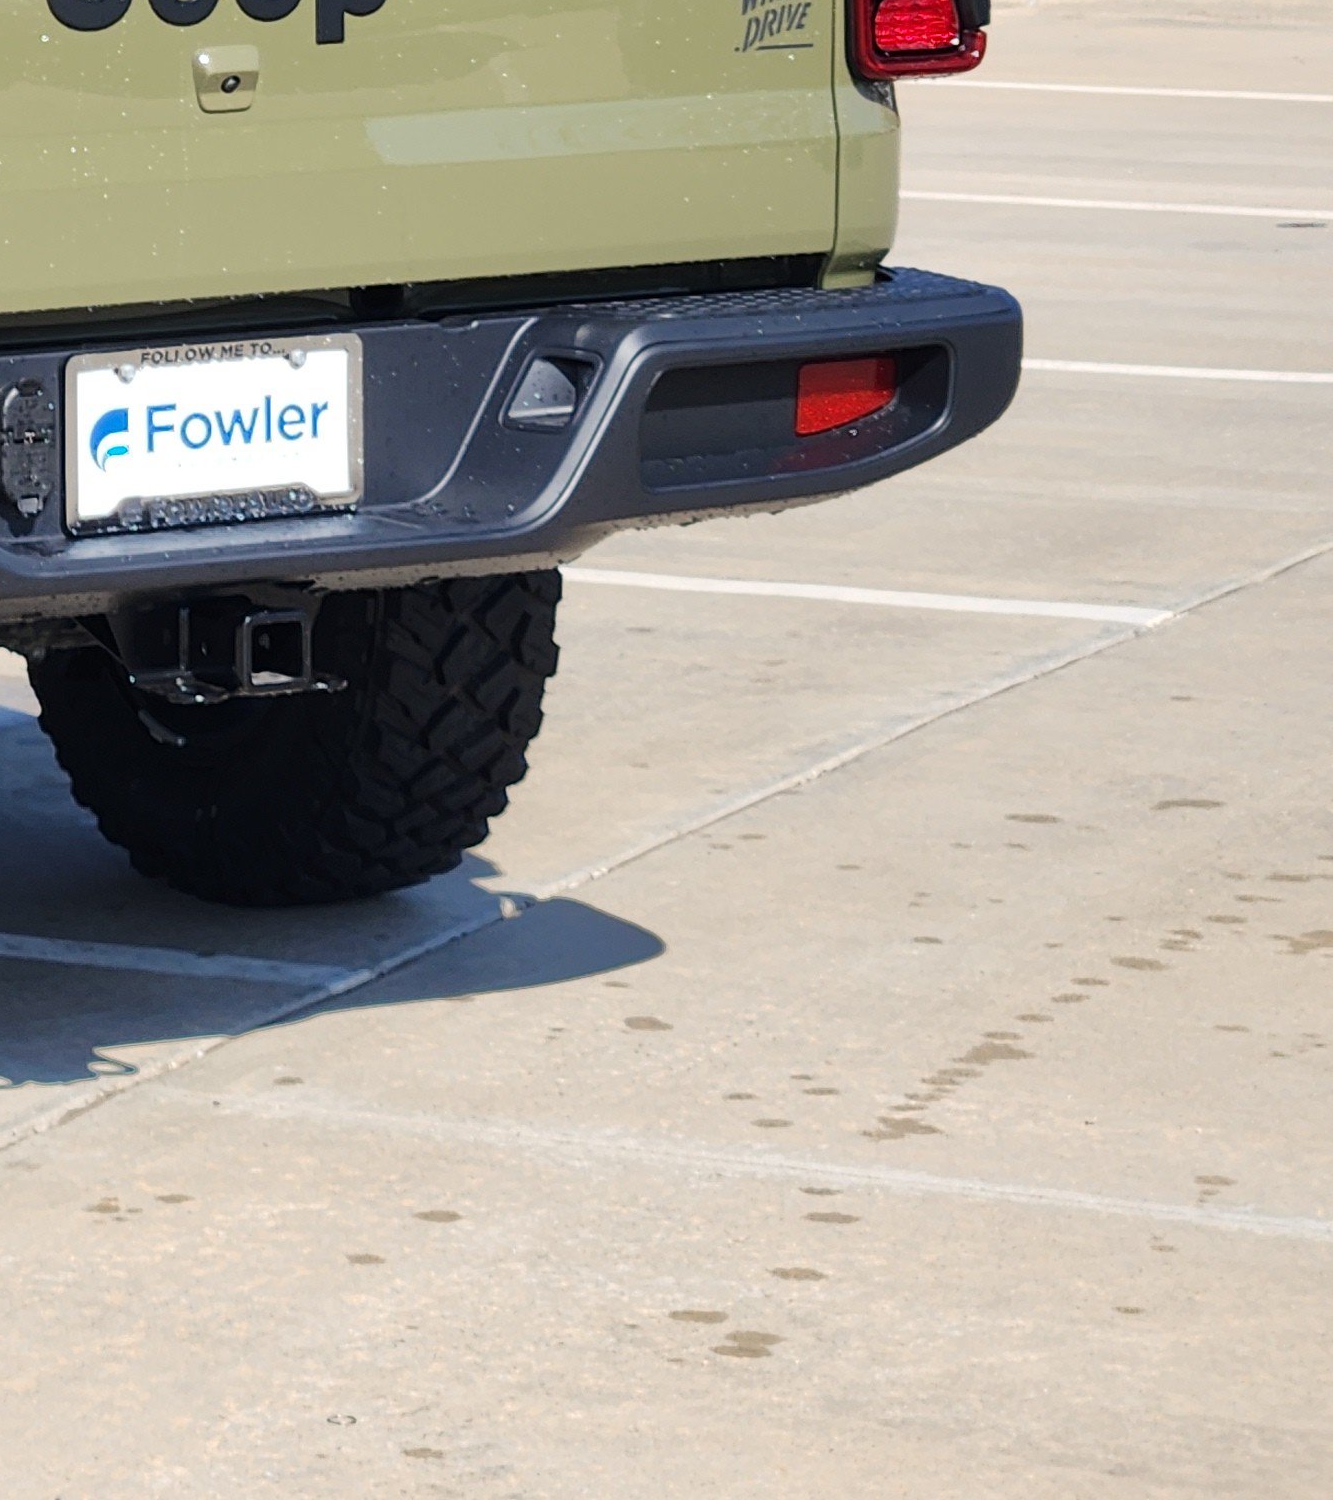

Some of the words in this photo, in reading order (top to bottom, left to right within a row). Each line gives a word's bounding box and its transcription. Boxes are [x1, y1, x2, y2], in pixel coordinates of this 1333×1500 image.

[742, 2, 812, 52] DRIVE
[140, 346, 215, 365] FOLLOW
[220, 344, 244, 358] ME
[147, 395, 328, 452] Fowler
